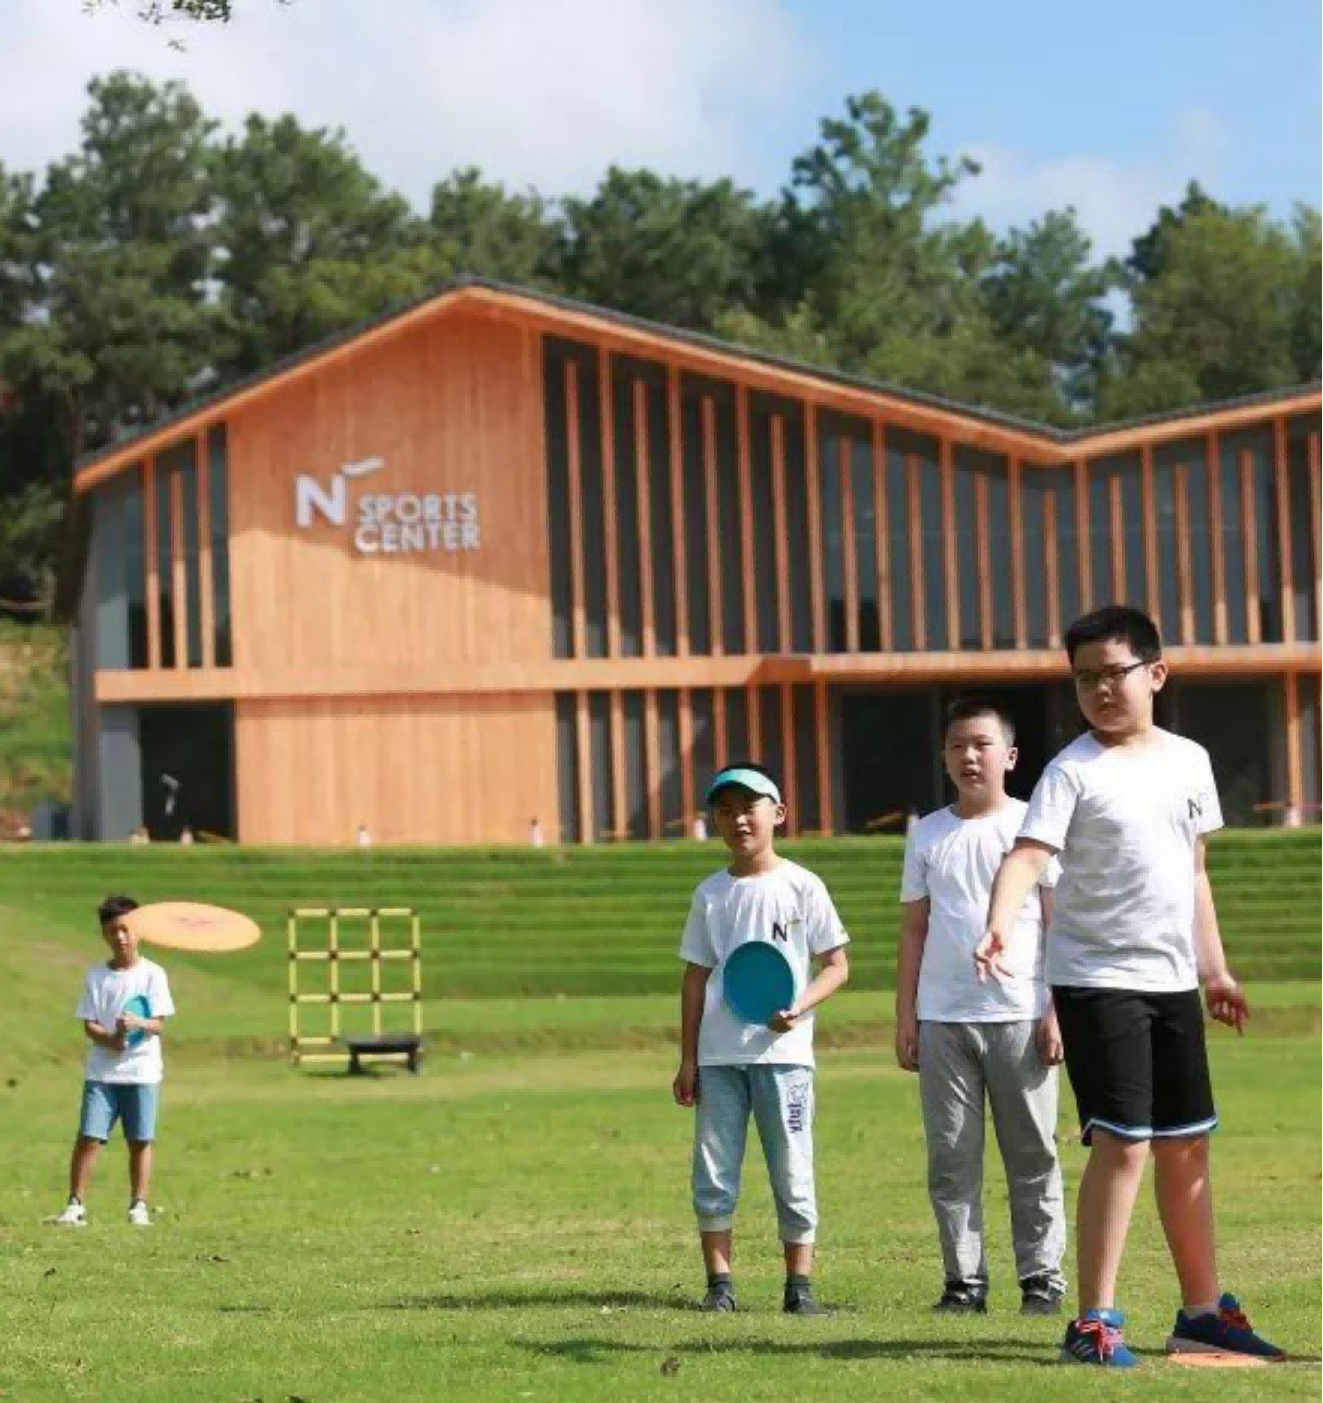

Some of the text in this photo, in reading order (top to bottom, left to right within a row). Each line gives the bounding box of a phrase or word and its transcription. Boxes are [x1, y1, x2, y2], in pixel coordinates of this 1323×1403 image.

[359, 494, 478, 526] SPORTS
[355, 524, 480, 552] CENTER
[772, 922, 787, 942] N
